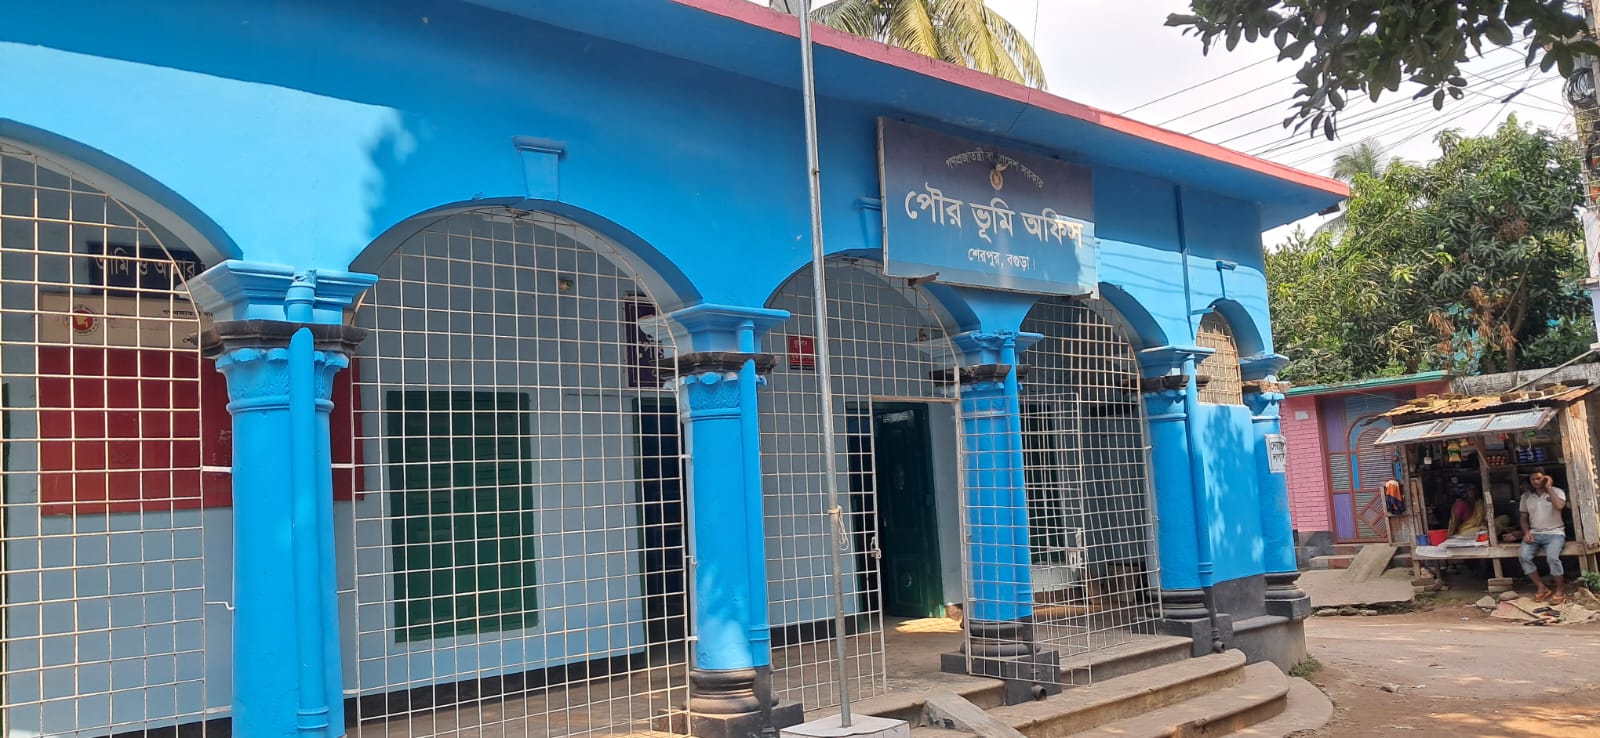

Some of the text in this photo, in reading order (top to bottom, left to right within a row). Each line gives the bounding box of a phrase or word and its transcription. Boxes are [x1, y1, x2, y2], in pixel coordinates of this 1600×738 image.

[986, 152, 1019, 172] বালাদেশ
[905, 181, 1084, 248] পৌর ভূমি অফিস
